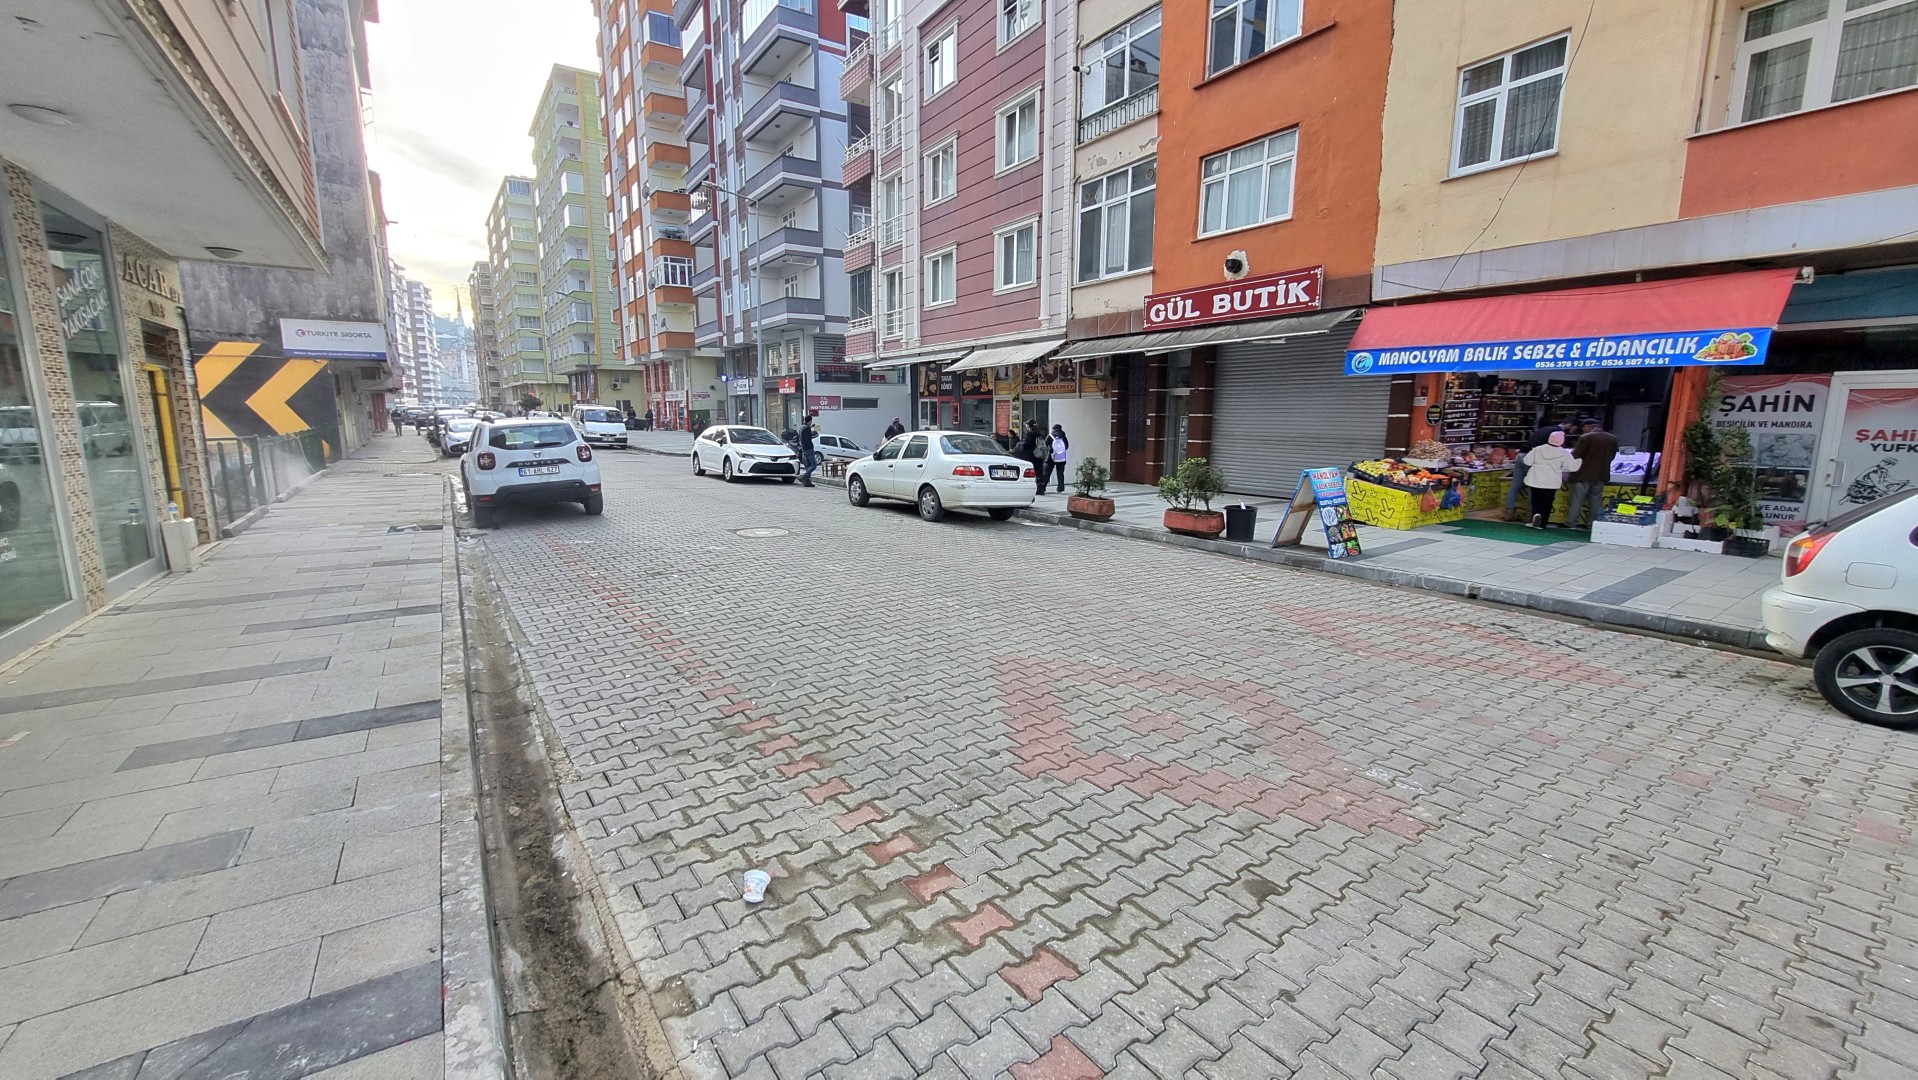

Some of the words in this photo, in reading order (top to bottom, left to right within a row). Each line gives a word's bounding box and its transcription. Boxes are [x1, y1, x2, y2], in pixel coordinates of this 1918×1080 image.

[1150, 297, 1200, 322] GÜL
[1212, 279, 1311, 315] BUTİK
[1378, 349, 1459, 366] MANOLYAM
[1463, 346, 1508, 362] BALIK
[1512, 343, 1567, 360] SEBZE
[1570, 342, 1581, 358] &
[1586, 336, 1699, 358] FİDANCILIK
[1718, 390, 1815, 417] ŞAHİN
[1855, 429, 1918, 443] ŞAHİ
[1760, 512, 1796, 520] UNUR
[1772, 505, 1800, 513] ADAK
